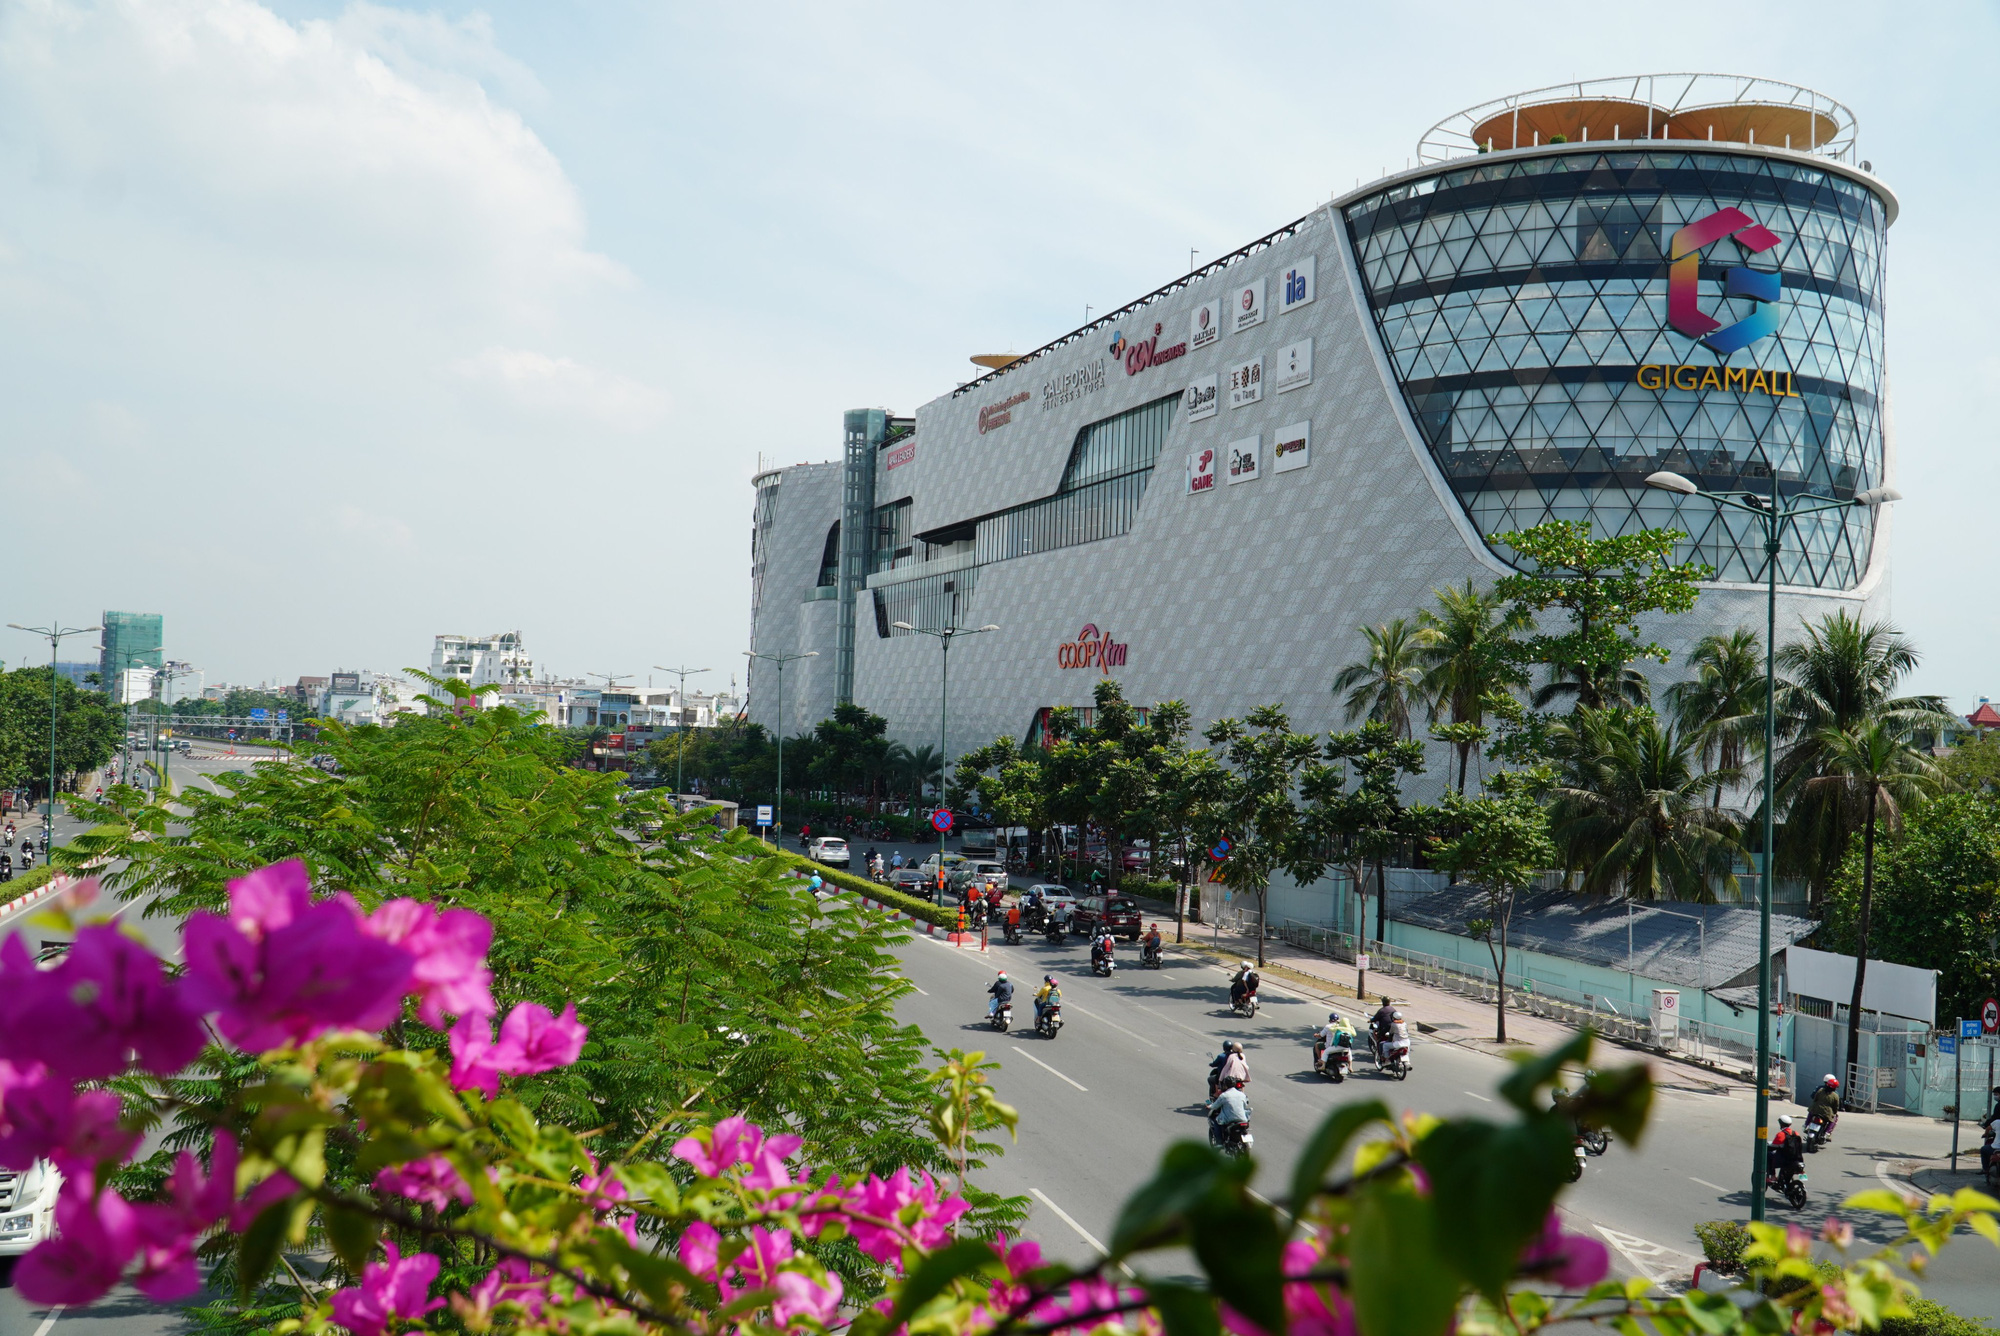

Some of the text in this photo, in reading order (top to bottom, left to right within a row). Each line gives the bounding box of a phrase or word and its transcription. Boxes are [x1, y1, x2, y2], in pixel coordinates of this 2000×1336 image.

[1286, 269, 1306, 305] ila
[1125, 336, 1186, 376] CGV CINEMAS
[1042, 391, 1073, 412] FITNESS
[1084, 378, 1105, 395] YOGA
[1043, 359, 1105, 399] CALIFORNIA
[1636, 364, 1800, 397] GIGAMALL
[1192, 474, 1213, 491] GAME
